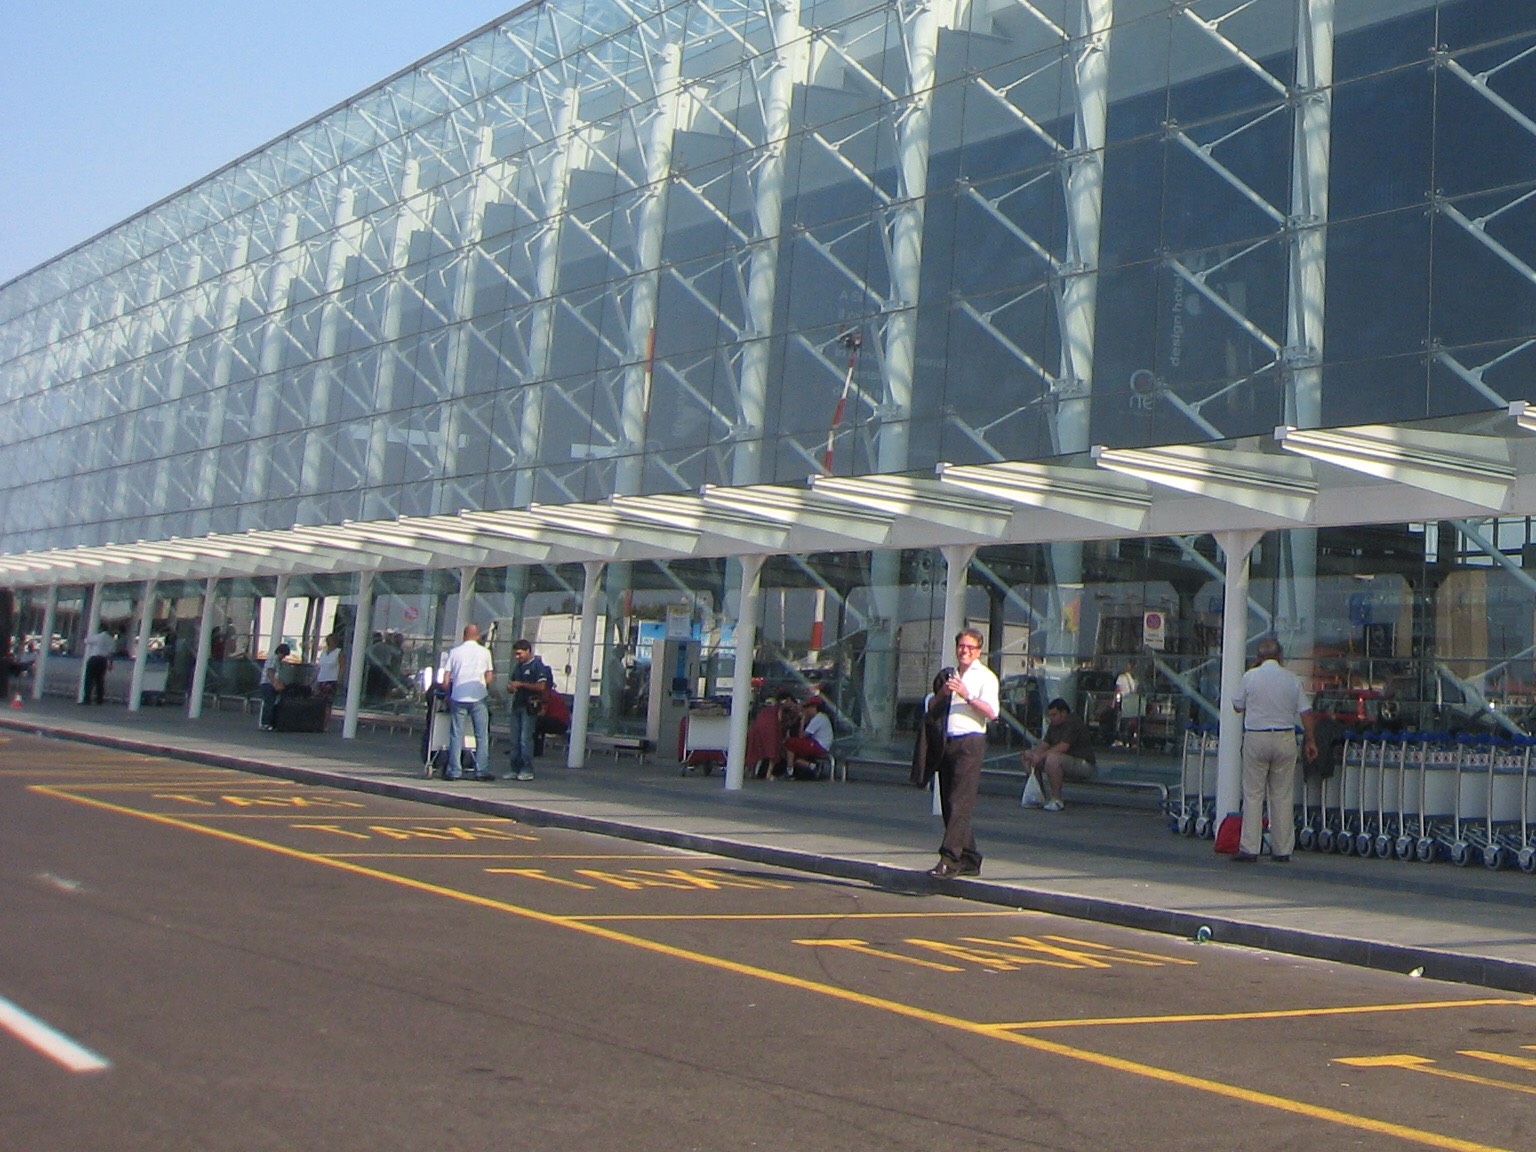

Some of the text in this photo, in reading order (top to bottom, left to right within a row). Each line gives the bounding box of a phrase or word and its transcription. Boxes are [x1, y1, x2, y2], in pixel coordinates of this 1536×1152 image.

[1169, 314, 1184, 367] design
[484, 868, 795, 890] TAXI
[791, 934, 1199, 974] TAXI
